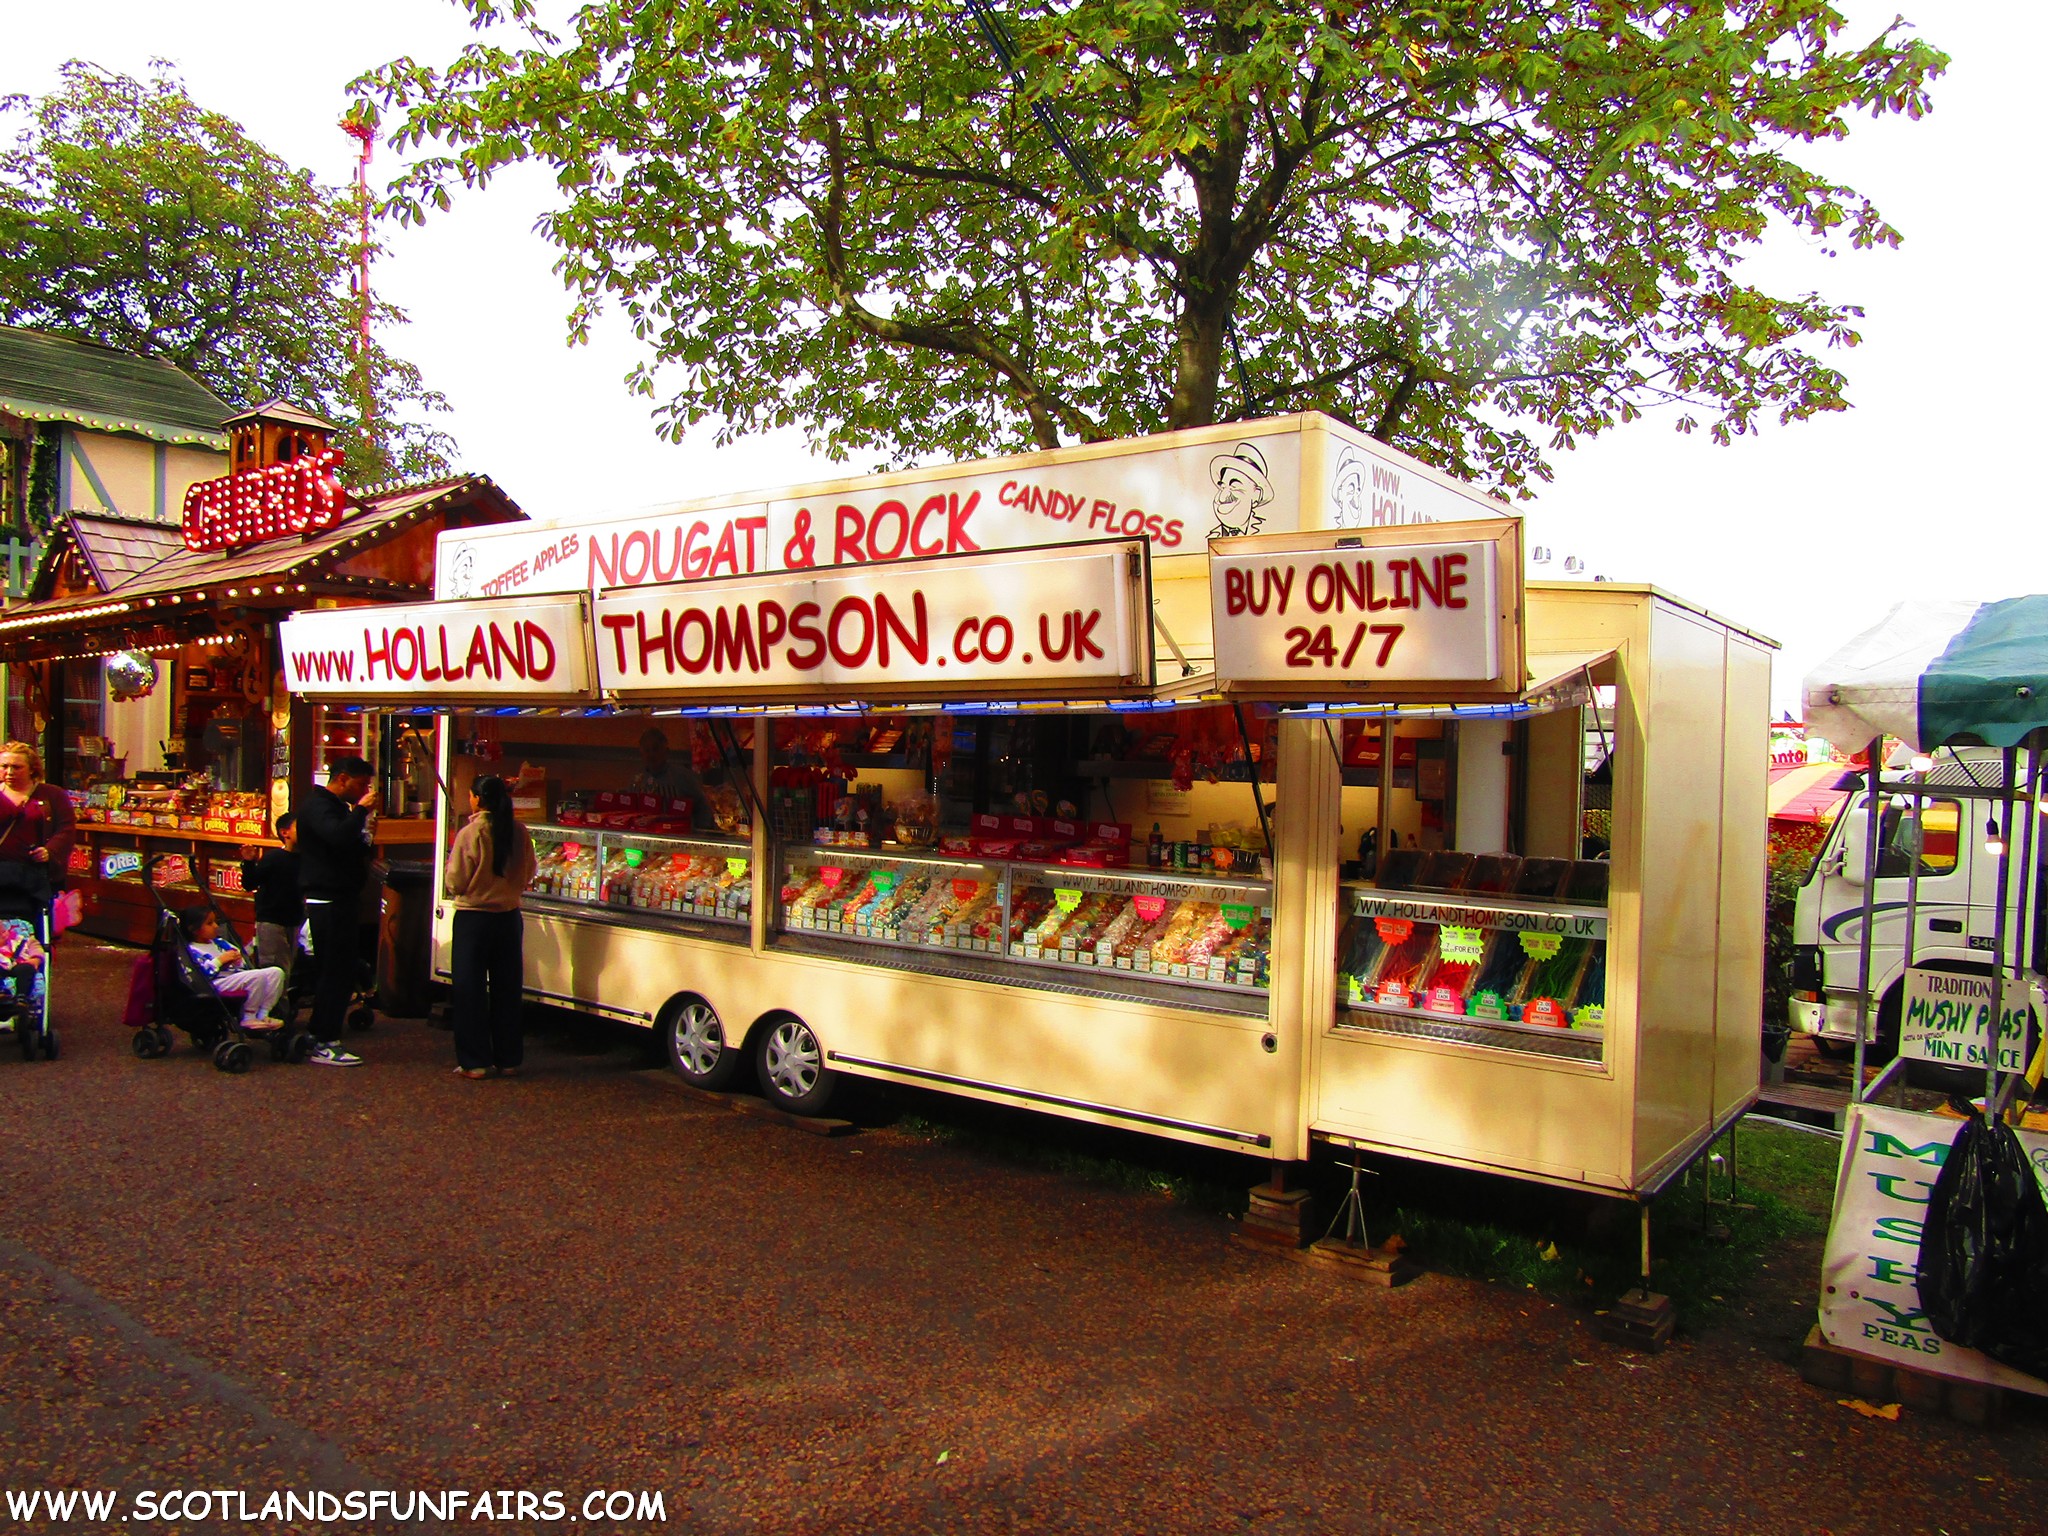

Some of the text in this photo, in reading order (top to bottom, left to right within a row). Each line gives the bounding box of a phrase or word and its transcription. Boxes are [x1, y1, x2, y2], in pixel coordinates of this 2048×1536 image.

[182, 448, 345, 553] CHURROS
[998, 480, 1185, 547] CANDY FLOSS
[588, 490, 982, 589] NOUGAT & ROCK
[481, 533, 580, 597] TOFFEE APPLES
[1225, 552, 1468, 617] BUY ONLINE
[1285, 622, 1405, 668] 24/7
[205, 820, 230, 833] CHURROS
[235, 821, 262, 836] CHURROS
[106, 853, 139, 874] OREO
[216, 867, 242, 891] nute
[1906, 996, 2027, 1040] MUSHY PAS
[1924, 1040, 2020, 1069] MINT SACE
[1862, 1322, 1941, 1354] PEAS
